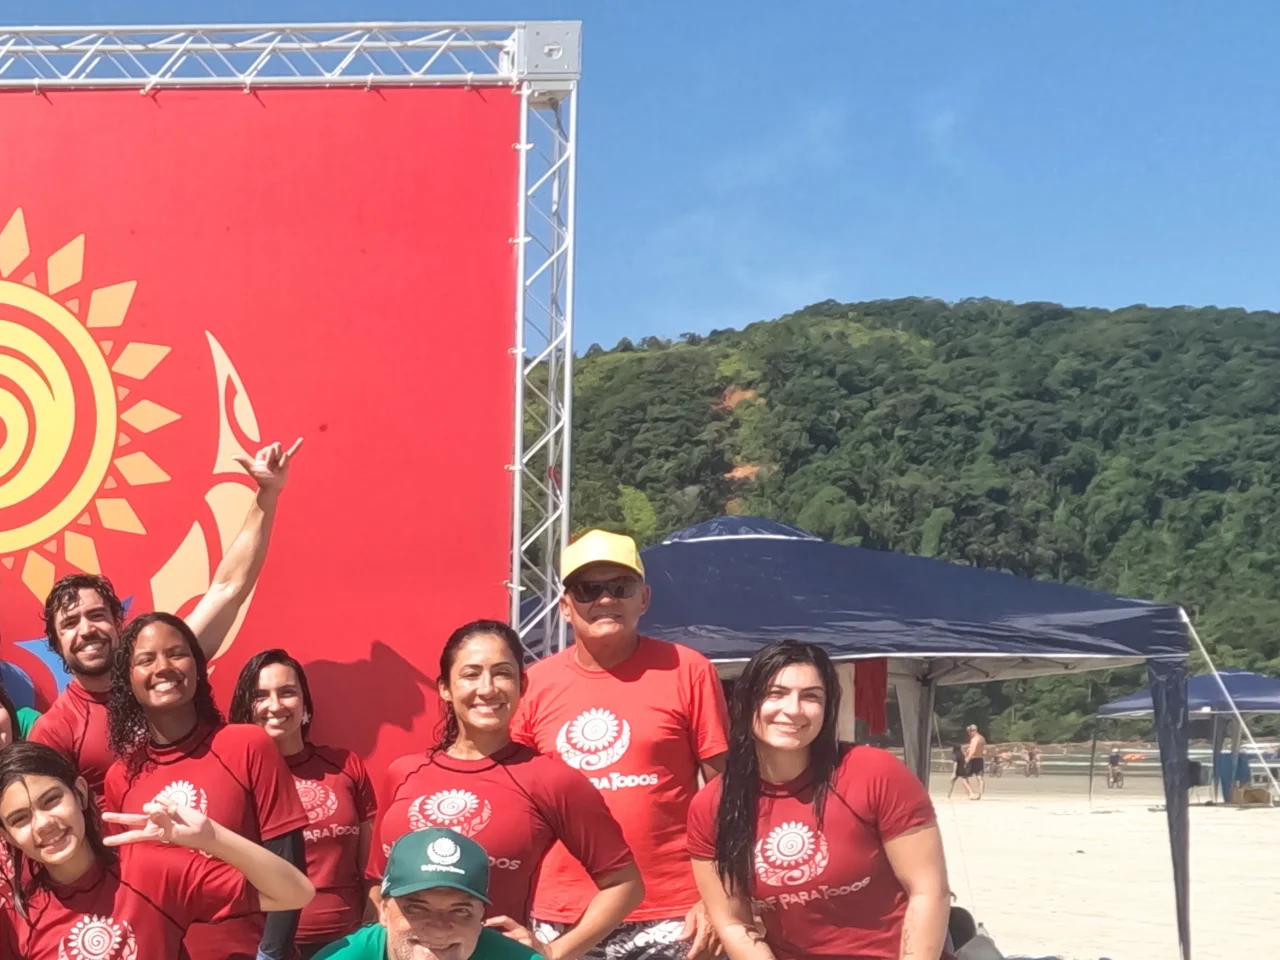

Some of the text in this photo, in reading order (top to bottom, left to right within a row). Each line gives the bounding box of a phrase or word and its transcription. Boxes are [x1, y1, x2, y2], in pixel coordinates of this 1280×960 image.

[609, 772, 659, 791] TODOS
[779, 889, 821, 910] PARA
[818, 876, 871, 900] TODOS
